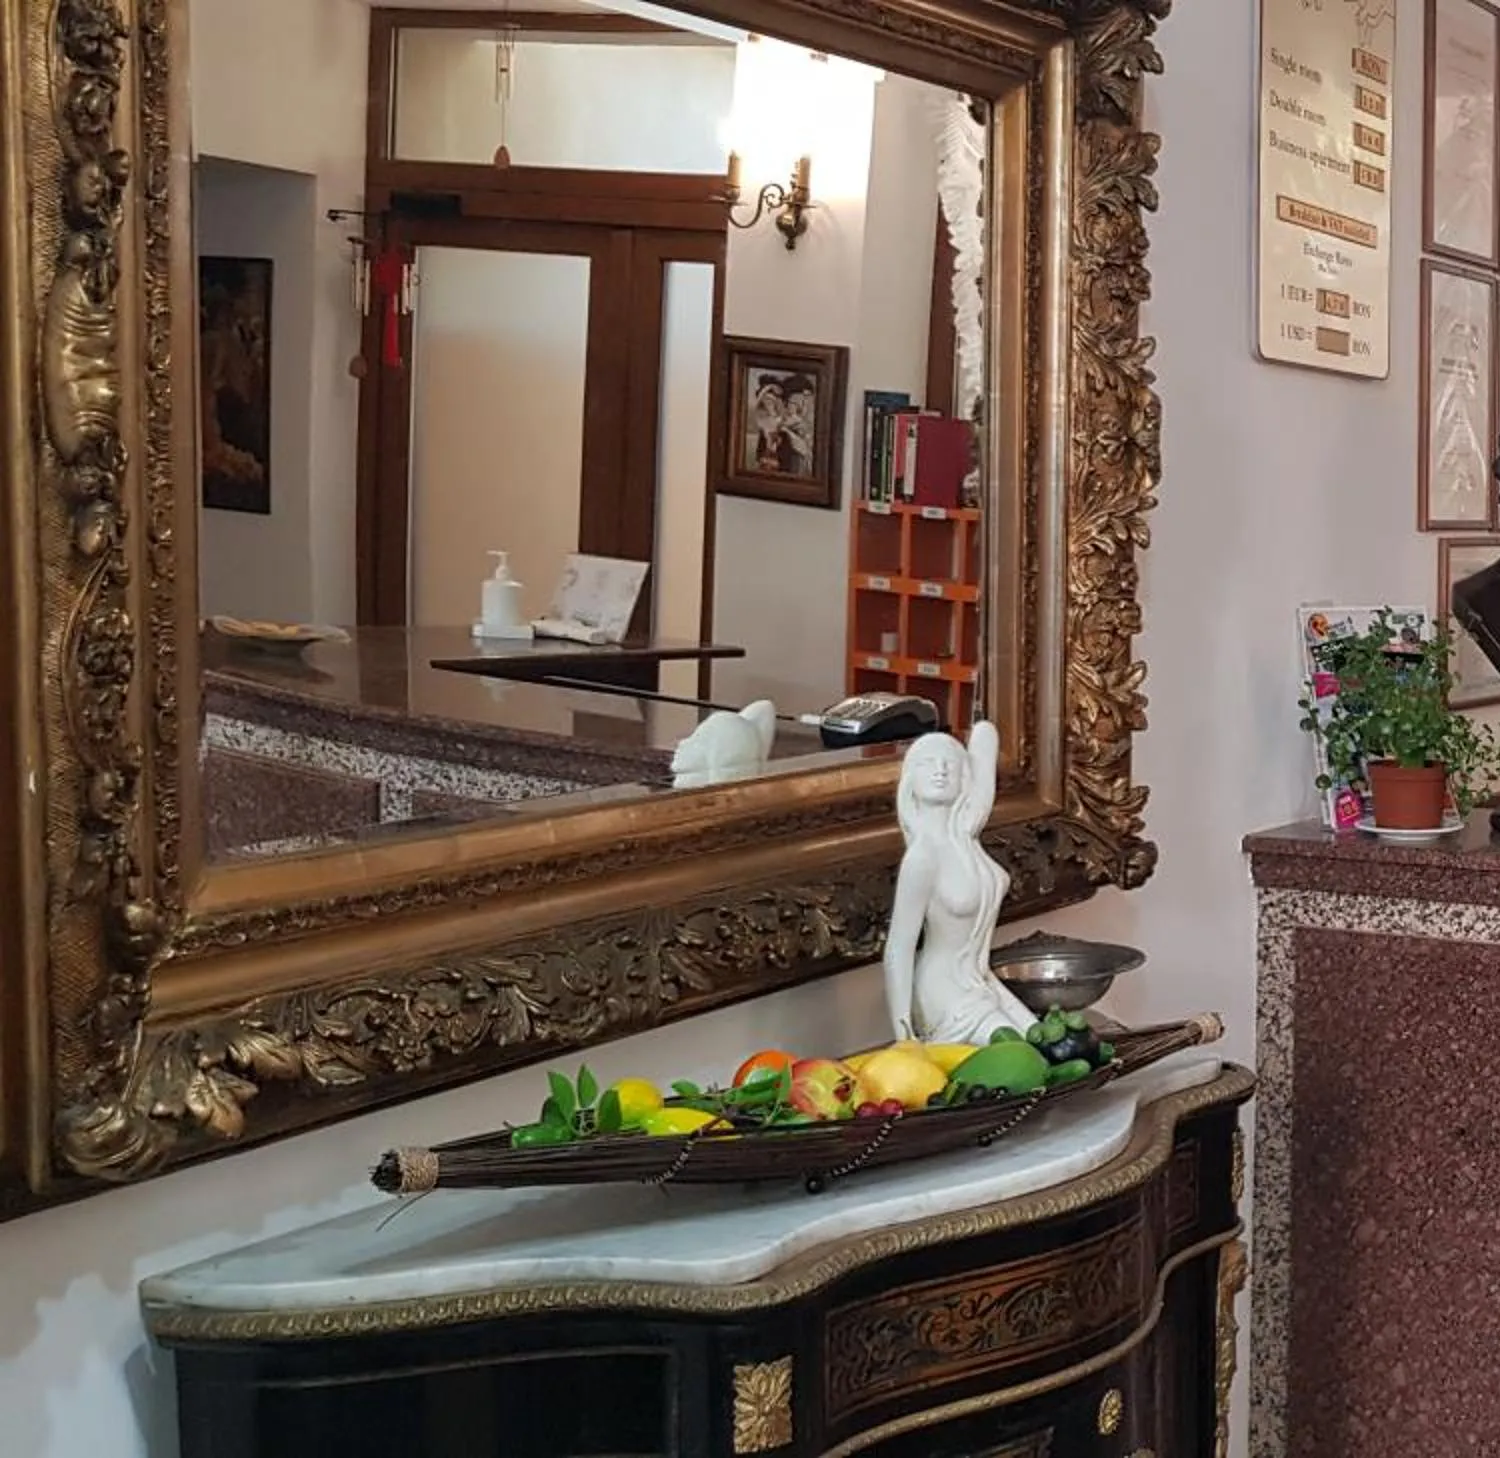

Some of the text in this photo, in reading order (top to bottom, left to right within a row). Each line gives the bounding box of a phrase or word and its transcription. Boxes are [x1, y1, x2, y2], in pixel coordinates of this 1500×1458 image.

[1271, 47, 1322, 83] Single room
[1270, 89, 1326, 126] Double room
[1269, 129, 1351, 174] Business apartment
